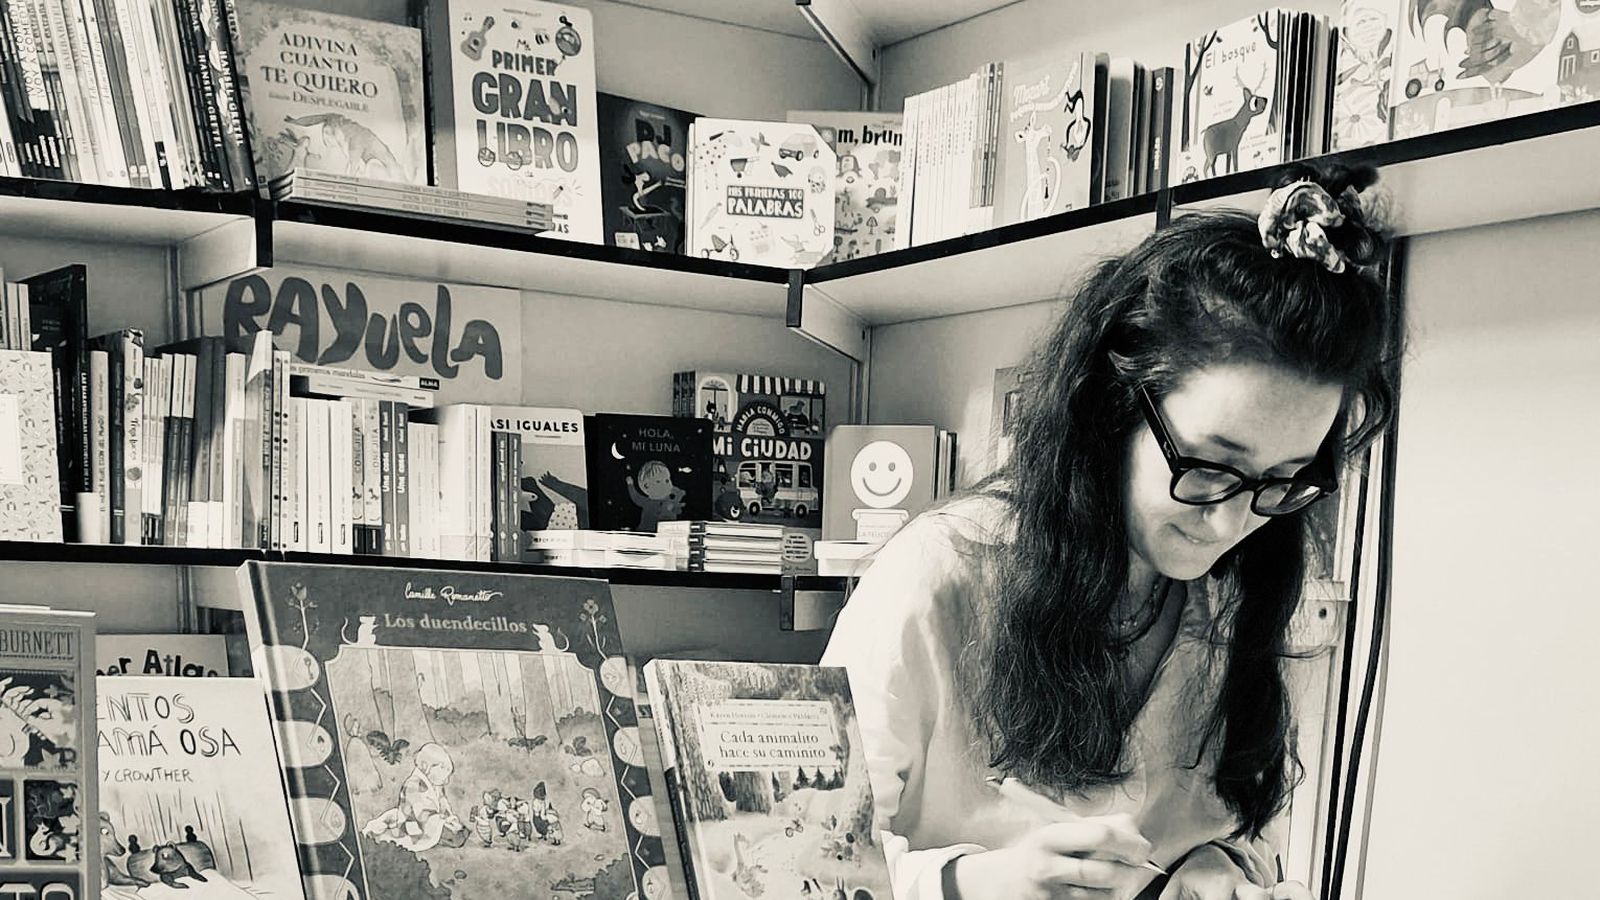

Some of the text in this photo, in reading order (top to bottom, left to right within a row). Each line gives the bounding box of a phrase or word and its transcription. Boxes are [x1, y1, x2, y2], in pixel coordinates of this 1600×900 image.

[281, 32, 358, 57] ADIVINA
[1205, 41, 1257, 69] El bosque
[492, 49, 558, 77] PRIMER
[260, 65, 379, 99] TE QUIERO
[198, 54, 214, 98] HANSEL
[207, 106, 223, 148] GRETEL
[219, 50, 235, 97] HANSEL
[228, 102, 245, 146] GRETEL
[472, 71, 578, 127] GRAN
[476, 118, 579, 173] LIBRO
[635, 118, 672, 147] DJ
[625, 140, 685, 173] PACO
[727, 197, 804, 218] PALABRAS
[517, 419, 579, 433] IGUALES
[631, 441, 681, 453] MI LUNA
[384, 613, 528, 633] Los duendecillos
[0, 629, 74, 656] BURNETT
[179, 725, 242, 758] OSA
[720, 730, 820, 745] Cada animalito
[719, 745, 826, 760] hace su caminito
[114, 766, 193, 783] CROWTHER
